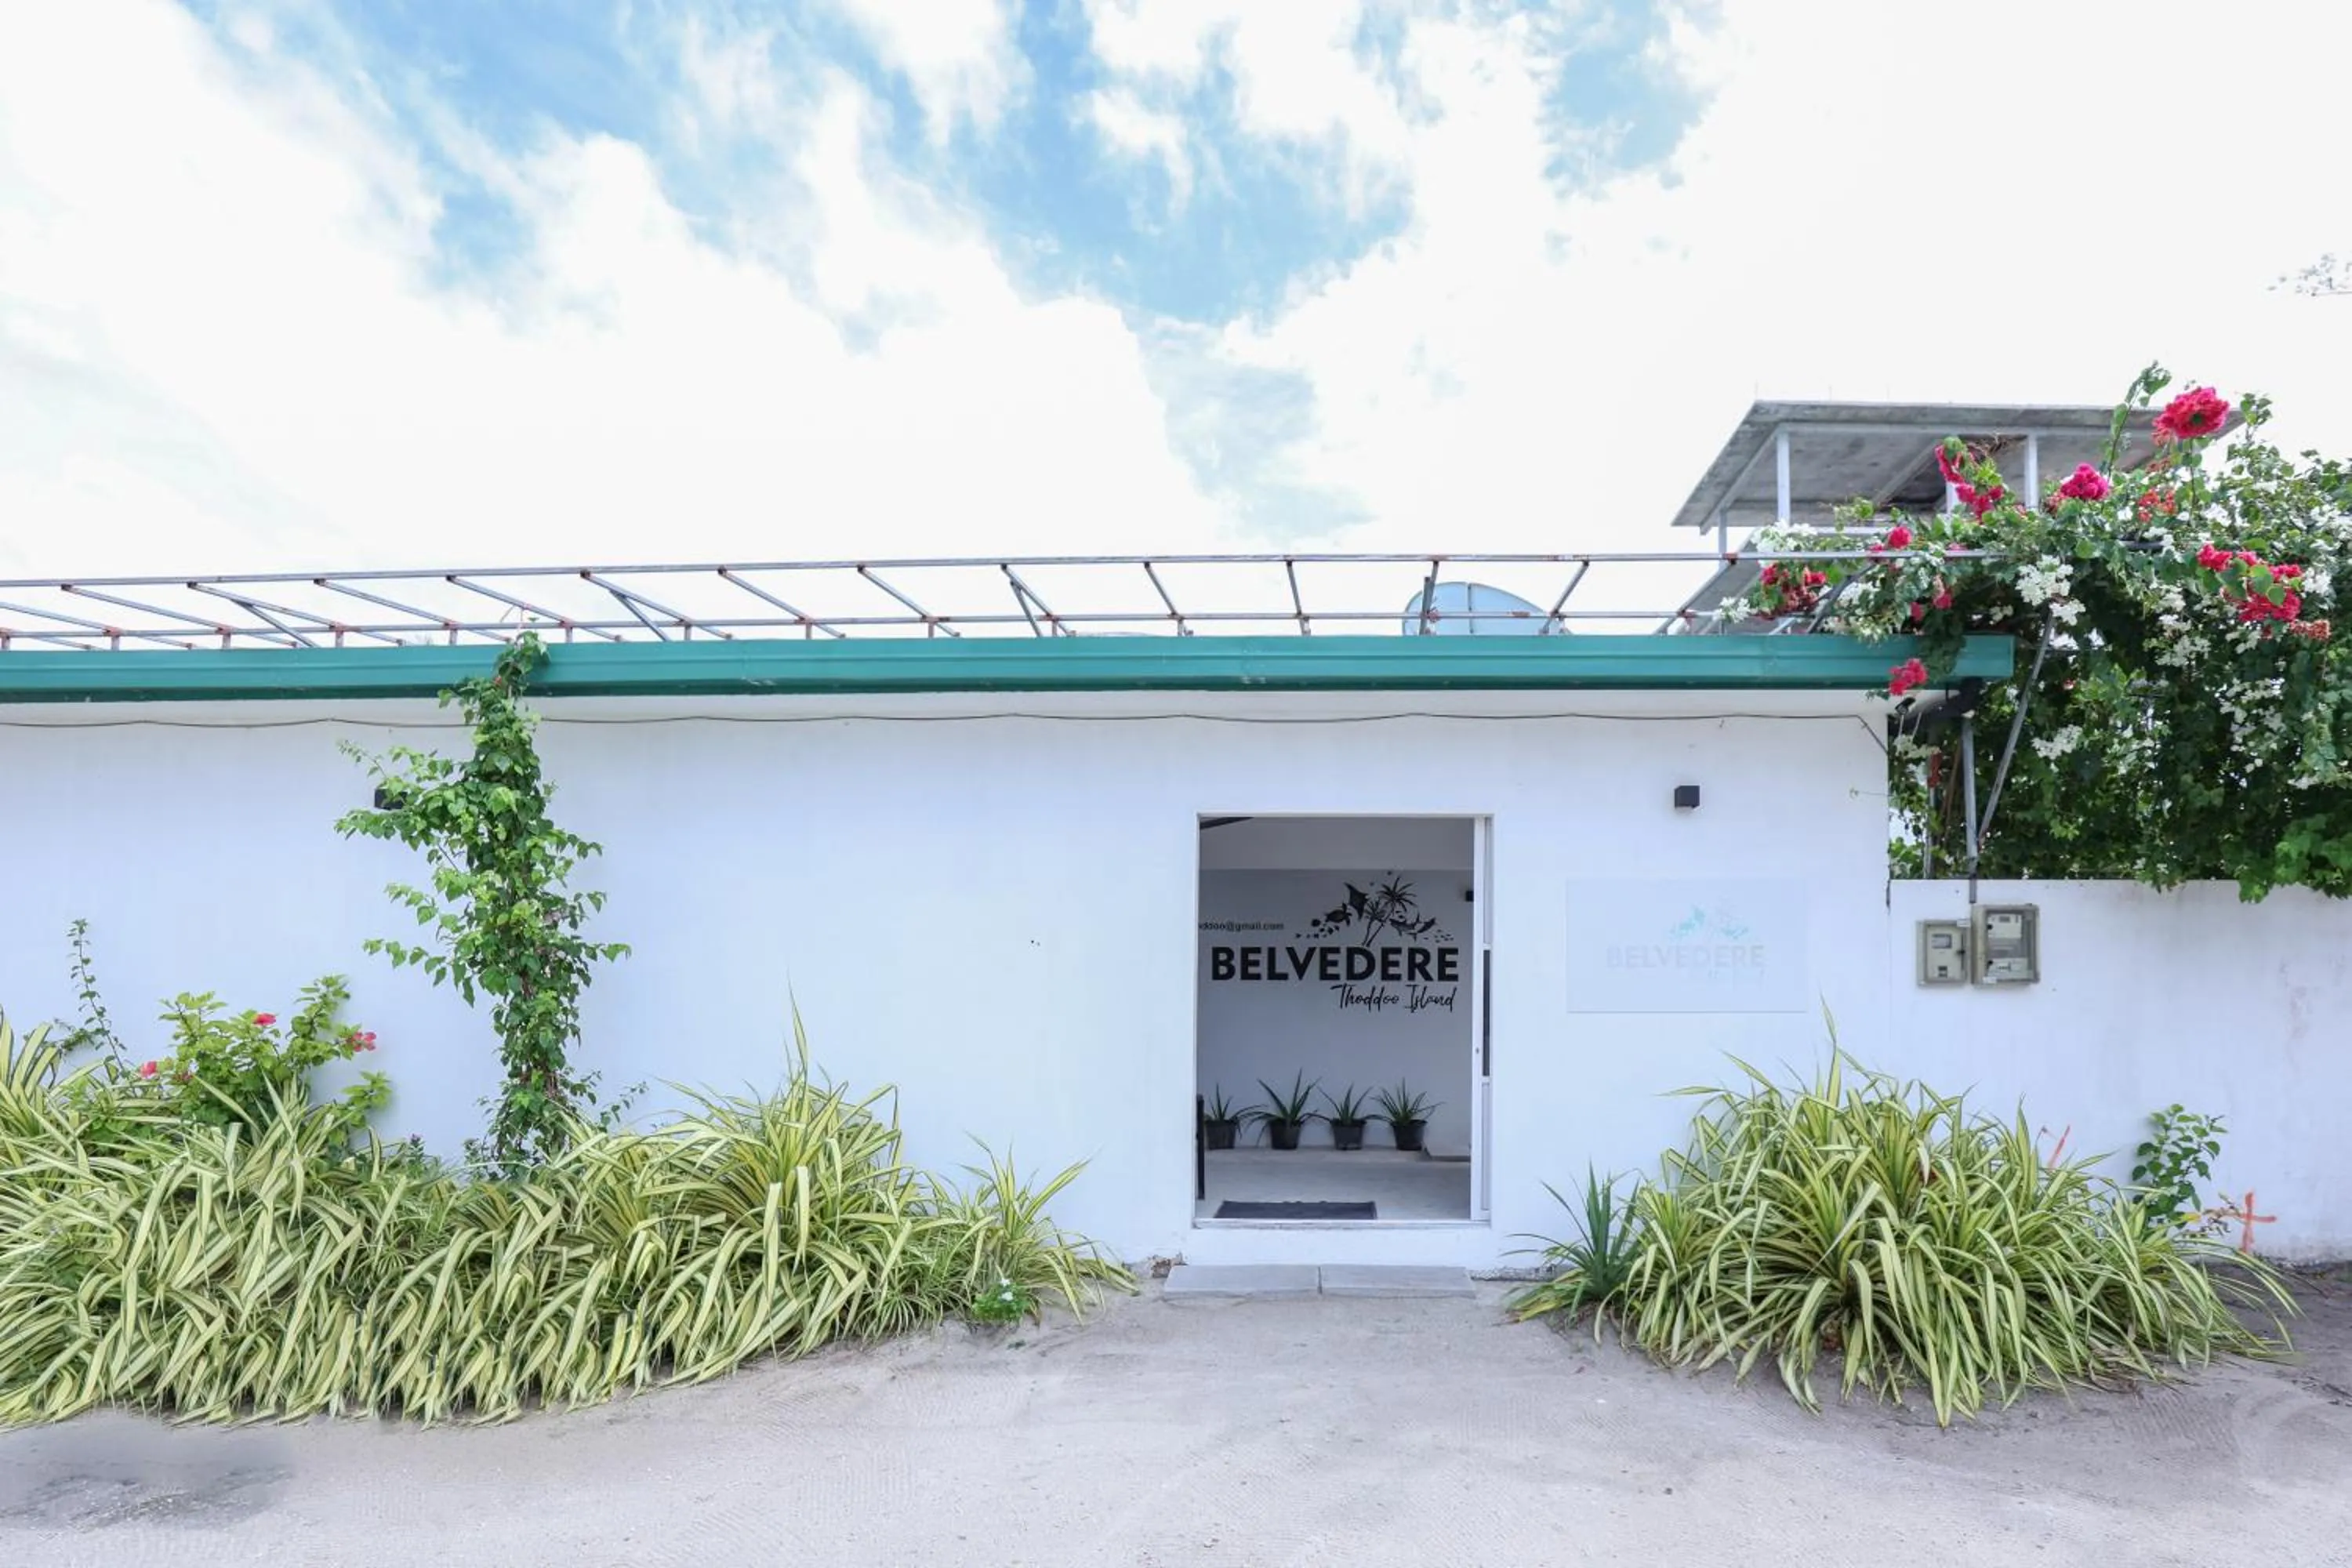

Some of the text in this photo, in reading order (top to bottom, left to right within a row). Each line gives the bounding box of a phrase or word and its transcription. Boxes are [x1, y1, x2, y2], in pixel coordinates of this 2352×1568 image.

[1211, 946, 1459, 982] BELVEDERE
[1606, 944, 1765, 968] BELVEDERE
[1330, 983, 1457, 1013] Thoddoo Island
